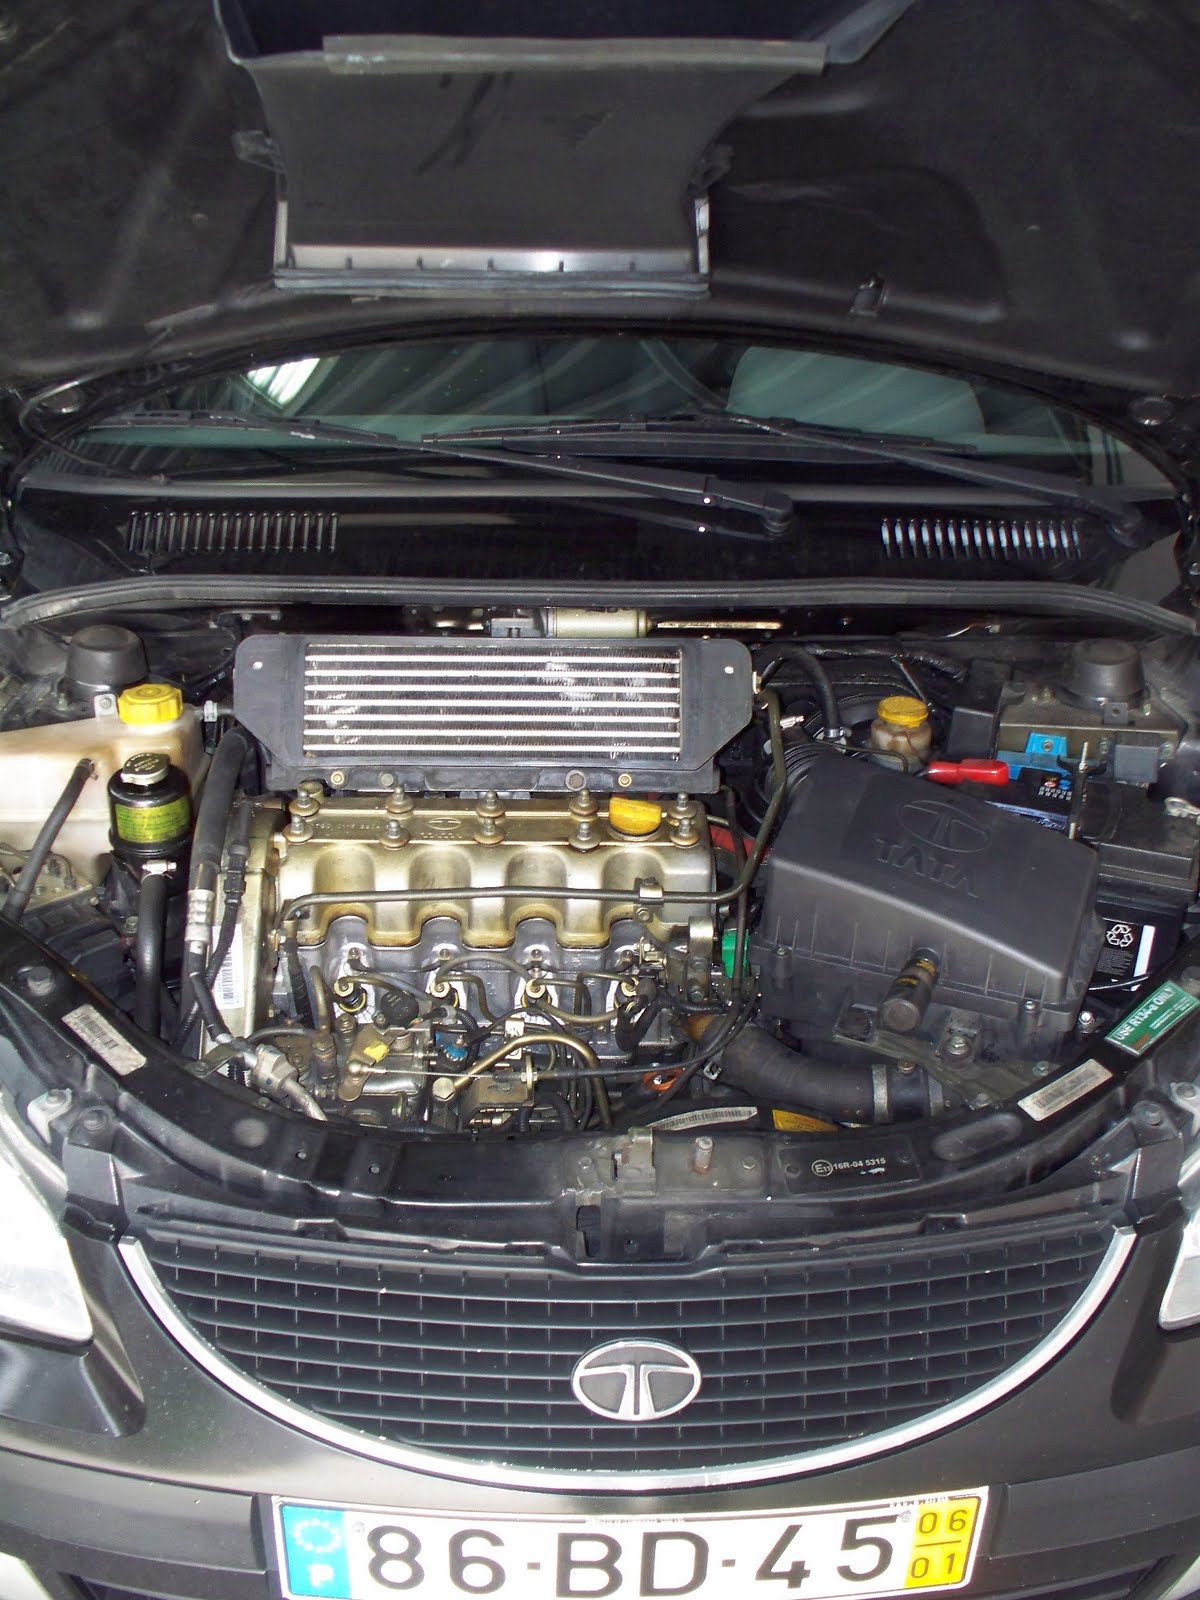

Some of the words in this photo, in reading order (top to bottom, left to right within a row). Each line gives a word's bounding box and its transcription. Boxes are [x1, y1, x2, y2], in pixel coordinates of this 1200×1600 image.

[873, 837, 979, 899] TATA
[1114, 1023, 1136, 1040] USE
[918, 1509, 968, 1534] 06
[309, 1563, 335, 1588] P
[910, 1553, 956, 1579] 01
